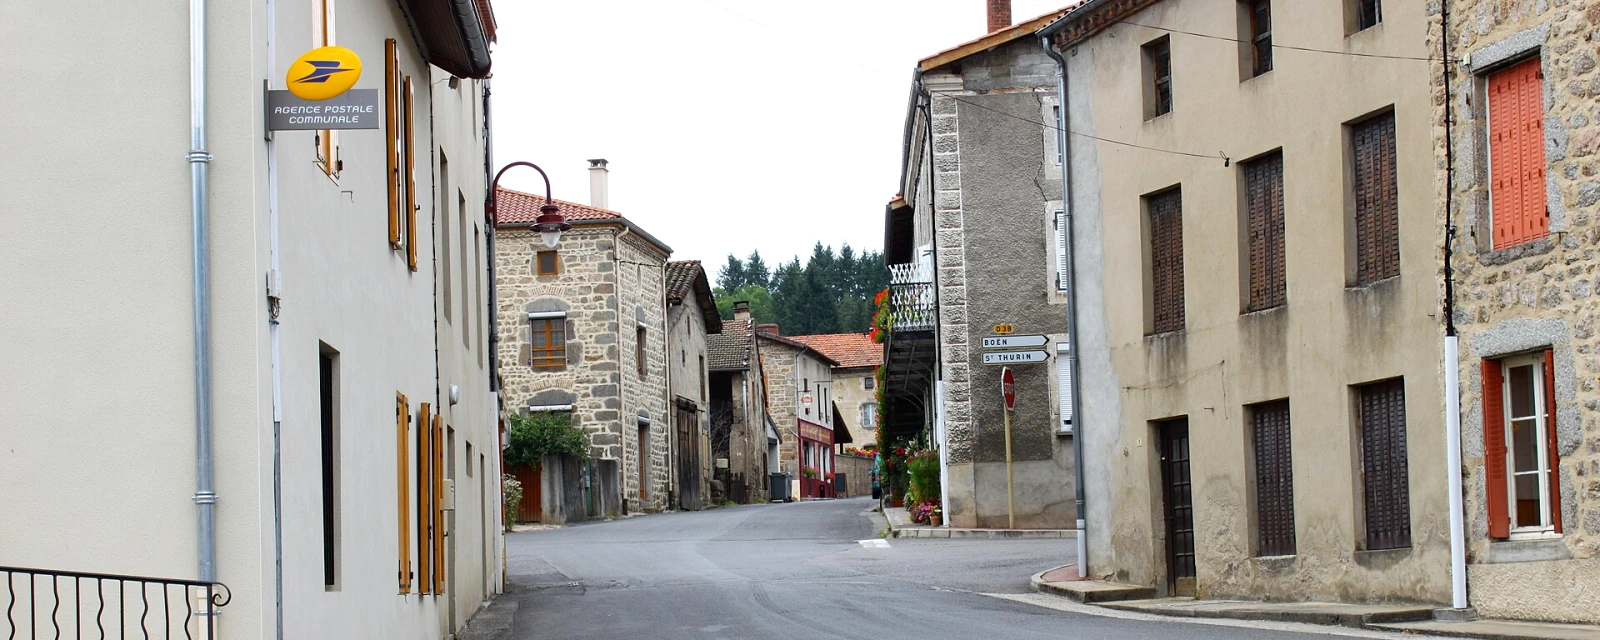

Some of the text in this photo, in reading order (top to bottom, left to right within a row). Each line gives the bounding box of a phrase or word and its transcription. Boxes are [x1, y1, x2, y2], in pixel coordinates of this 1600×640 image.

[274, 105, 374, 114] AGENCE POSTALE
[289, 115, 360, 124] COMMUNALE
[998, 353, 1032, 361] THURIN
